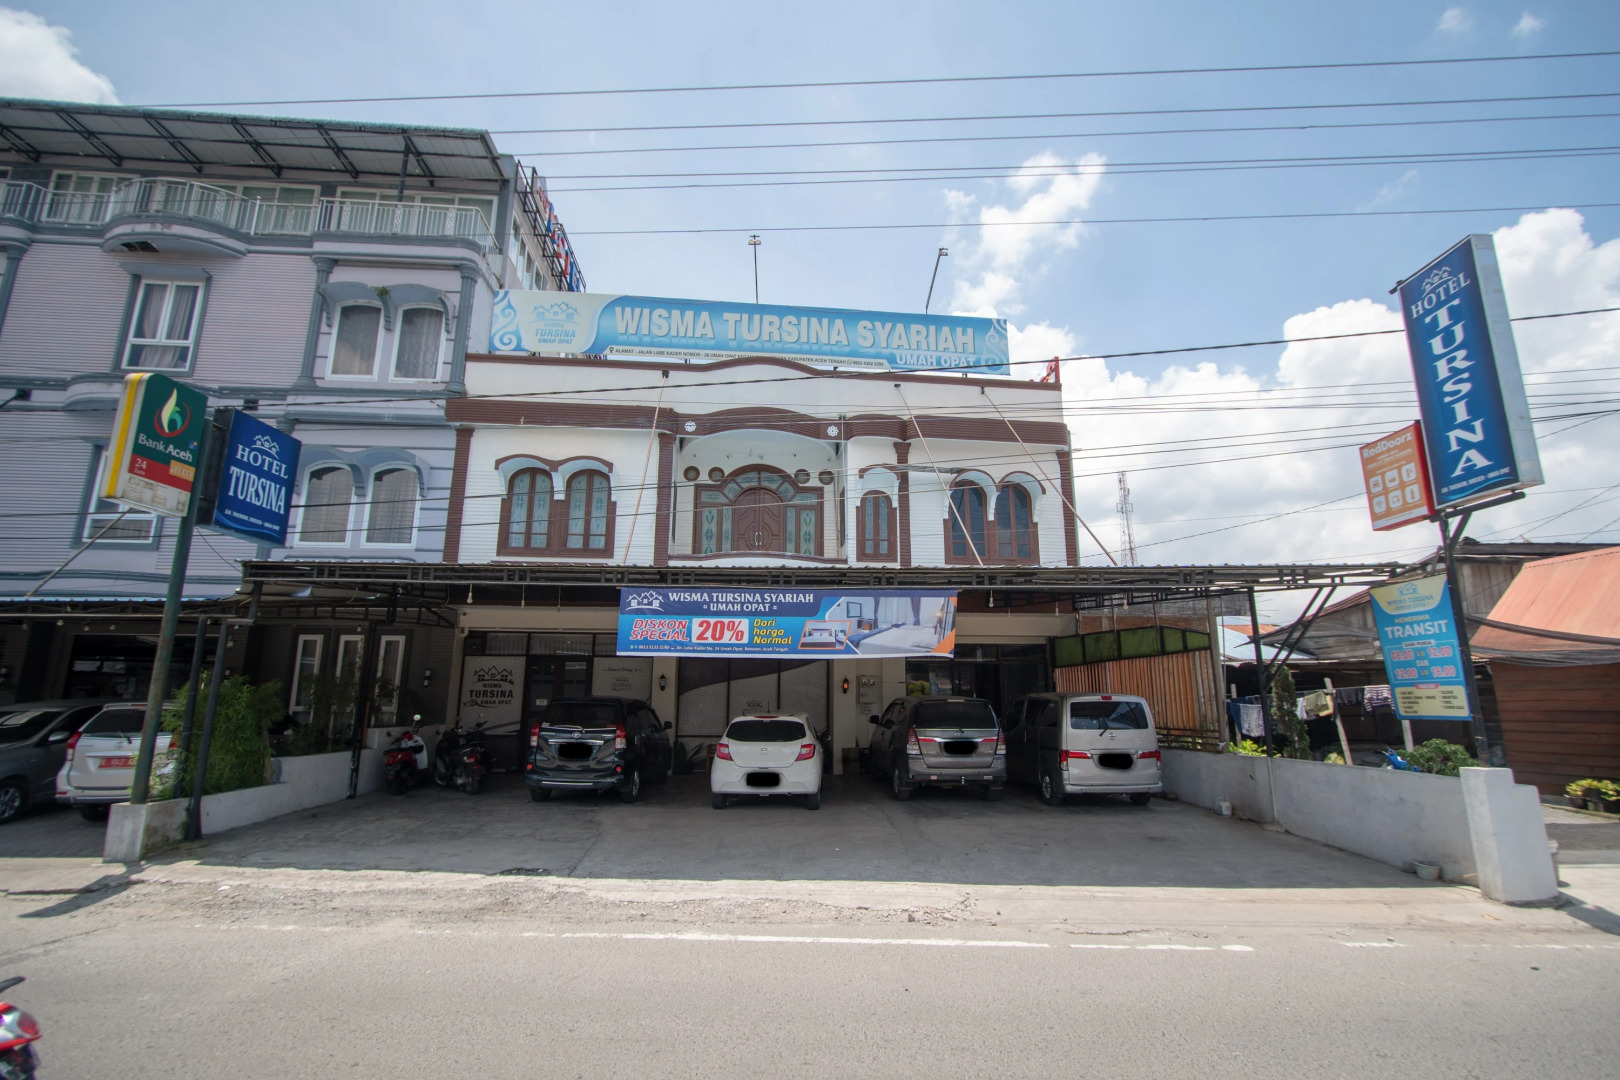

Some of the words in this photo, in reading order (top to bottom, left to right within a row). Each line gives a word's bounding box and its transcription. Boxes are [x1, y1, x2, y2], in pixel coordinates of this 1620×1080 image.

[1411, 272, 1471, 319] HOTEL
[535, 328, 576, 338] TURSINA
[615, 306, 715, 339] WISMA
[723, 314, 849, 346] TURSINA
[857, 323, 975, 354] SYARIAH
[896, 353, 936, 366] UMAH
[940, 356, 976, 368] OPAT
[1424, 298, 1494, 477] TURSINA
[138, 433, 165, 452] Bank
[166, 444, 193, 462] Aceh
[1362, 432, 1413, 459] RedDoorz
[135, 458, 147, 469] 24
[236, 444, 288, 479] HOTEL
[228, 465, 286, 514] TURSINA
[669, 592, 709, 602] WISMA
[712, 592, 762, 602] TURSINA
[764, 593, 814, 603] SYARIAH
[710, 603, 741, 611] UMAH
[743, 603, 770, 611] OPAT
[632, 619, 689, 630] DISKON
[752, 618, 776, 627] Dari
[630, 629, 689, 641] SPECIAL
[695, 619, 745, 641] 20%
[753, 627, 784, 637] harga
[1384, 620, 1448, 639] TRANSIT
[752, 636, 792, 645] Normal
[1427, 646, 1452, 658] 12.00
[1395, 668, 1417, 679] 12.00
[469, 689, 514, 699] TURSINA
